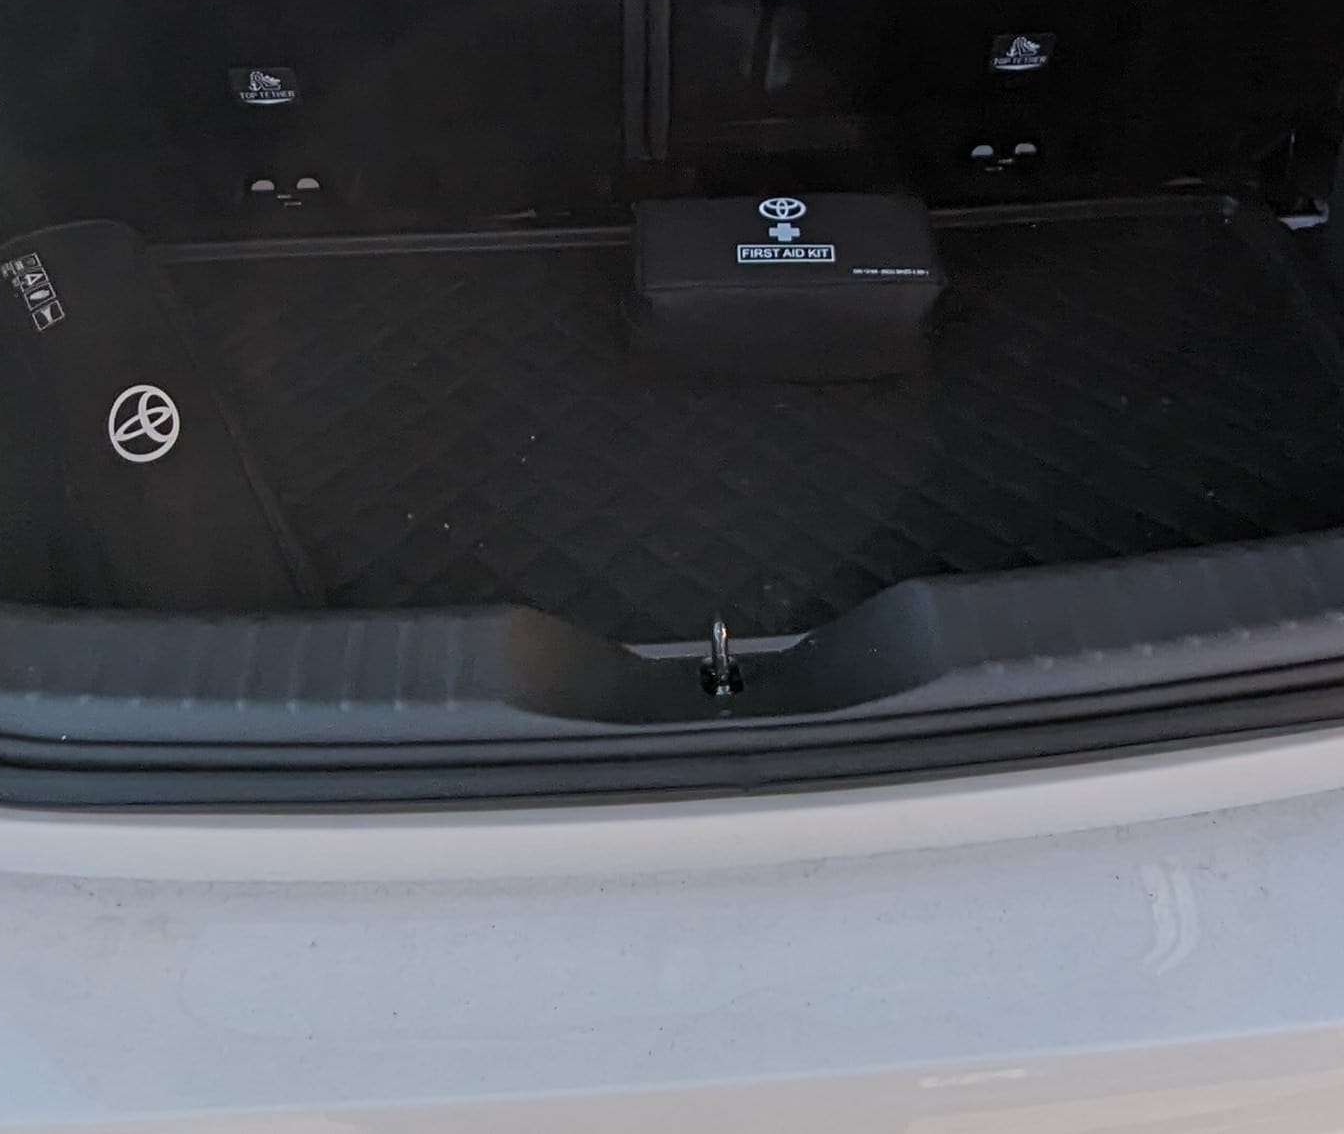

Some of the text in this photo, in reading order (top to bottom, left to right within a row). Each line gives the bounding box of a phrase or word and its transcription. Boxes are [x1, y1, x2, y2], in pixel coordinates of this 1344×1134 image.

[741, 248, 829, 259] FIRST AID KIT
